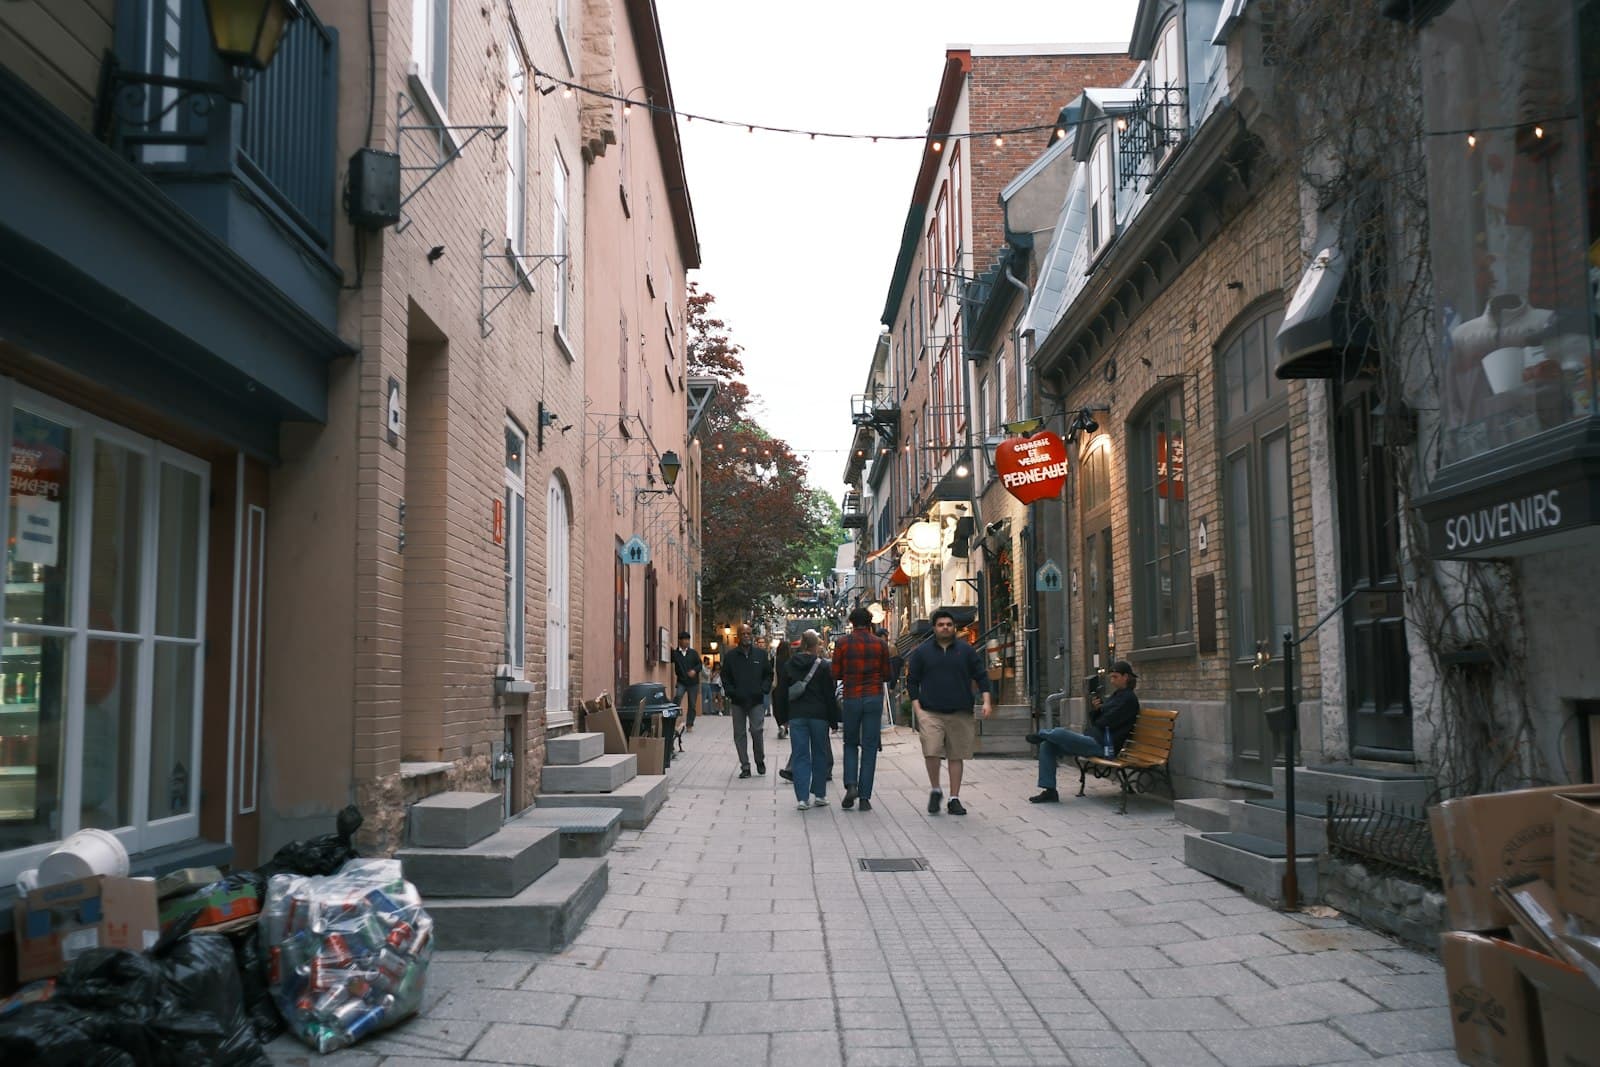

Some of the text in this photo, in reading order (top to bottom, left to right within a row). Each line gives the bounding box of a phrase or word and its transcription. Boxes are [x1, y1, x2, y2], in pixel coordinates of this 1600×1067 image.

[1003, 458, 1068, 488] PEDNEAULT
[1018, 453, 1052, 466] VERGER
[1446, 490, 1561, 550] SOUVENIRS
